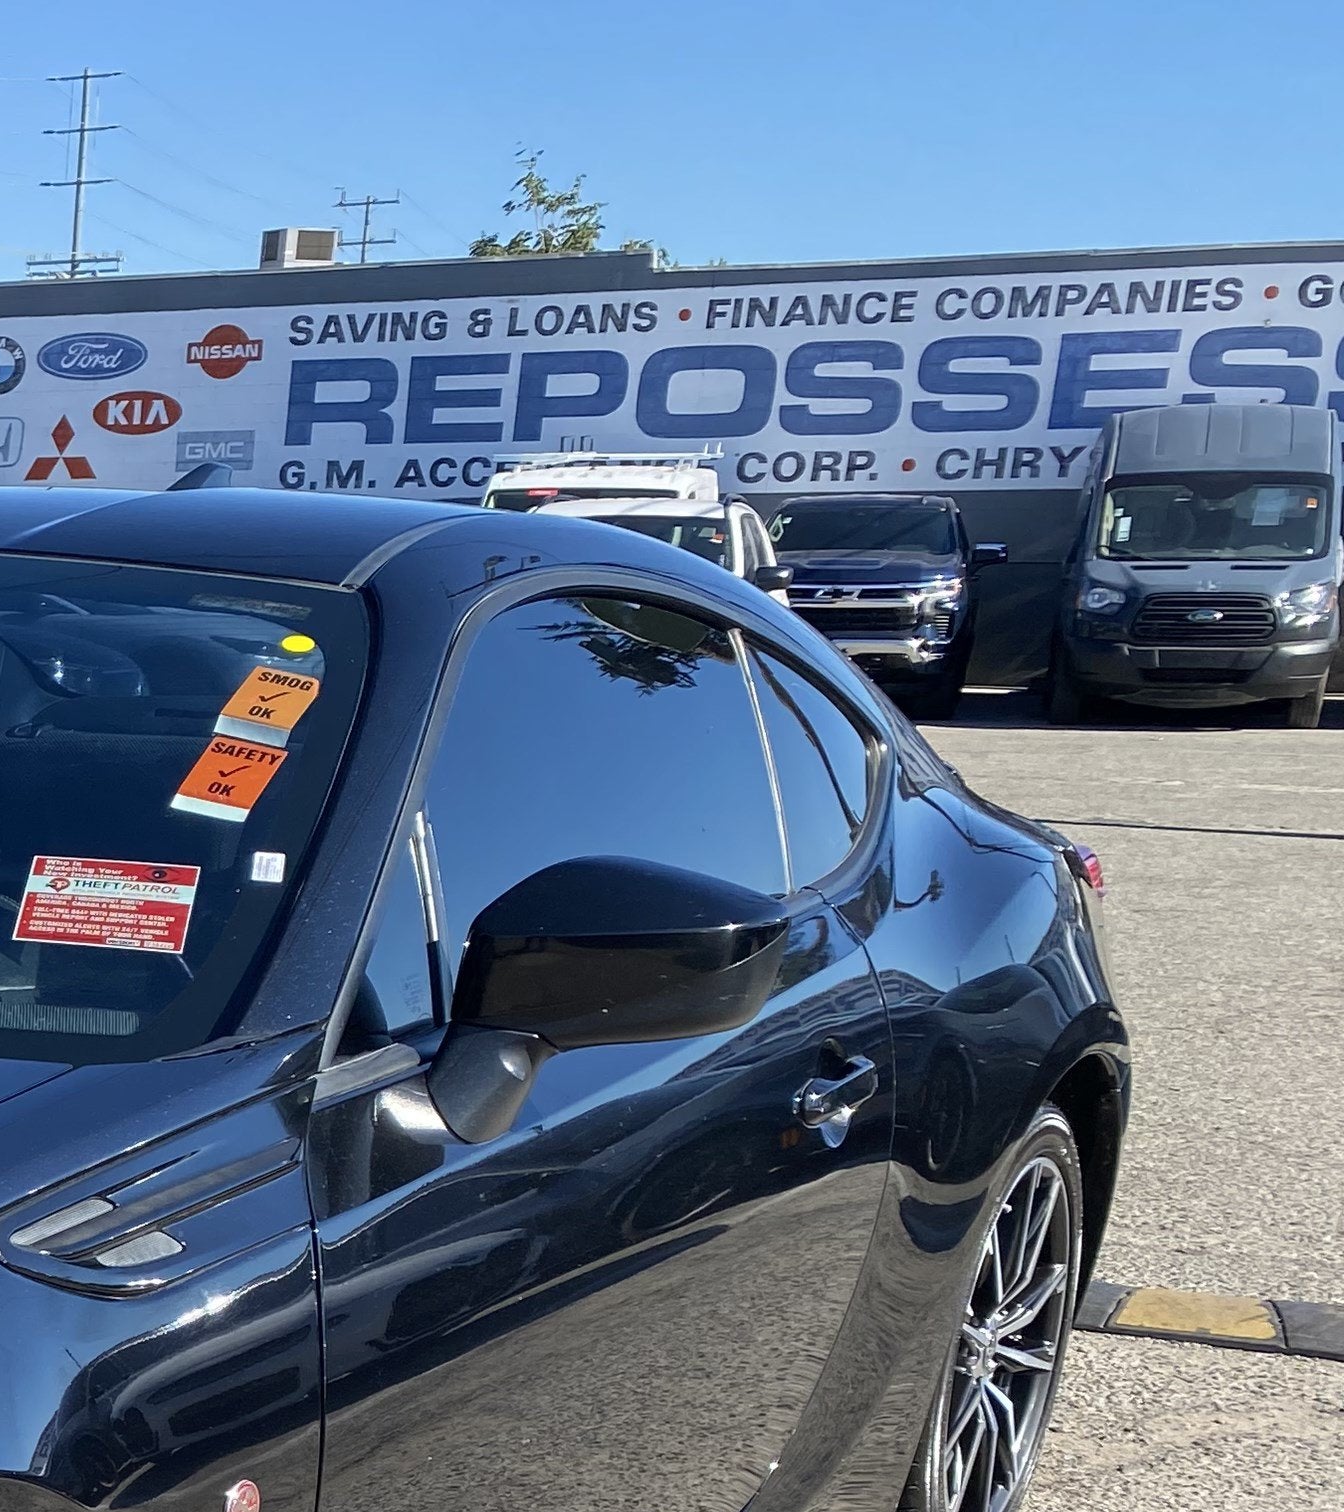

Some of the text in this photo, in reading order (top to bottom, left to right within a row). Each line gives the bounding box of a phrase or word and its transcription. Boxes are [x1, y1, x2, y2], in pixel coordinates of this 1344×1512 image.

[288, 274, 1344, 346] SAVING & LOANS FINANCE COMPANIES G
[61, 342, 122, 369] Ford
[190, 343, 259, 360] NISSAN
[284, 325, 1344, 446] REPOSSES
[107, 399, 170, 426] KIA
[185, 441, 245, 460] GMC
[279, 460, 376, 489] G.M.
[736, 450, 879, 484] CORP.
[258, 671, 314, 691] SMOG
[248, 705, 277, 719] OK
[210, 741, 282, 766] SAFETY
[207, 781, 236, 797] OK
[44, 865, 95, 874] Watching
